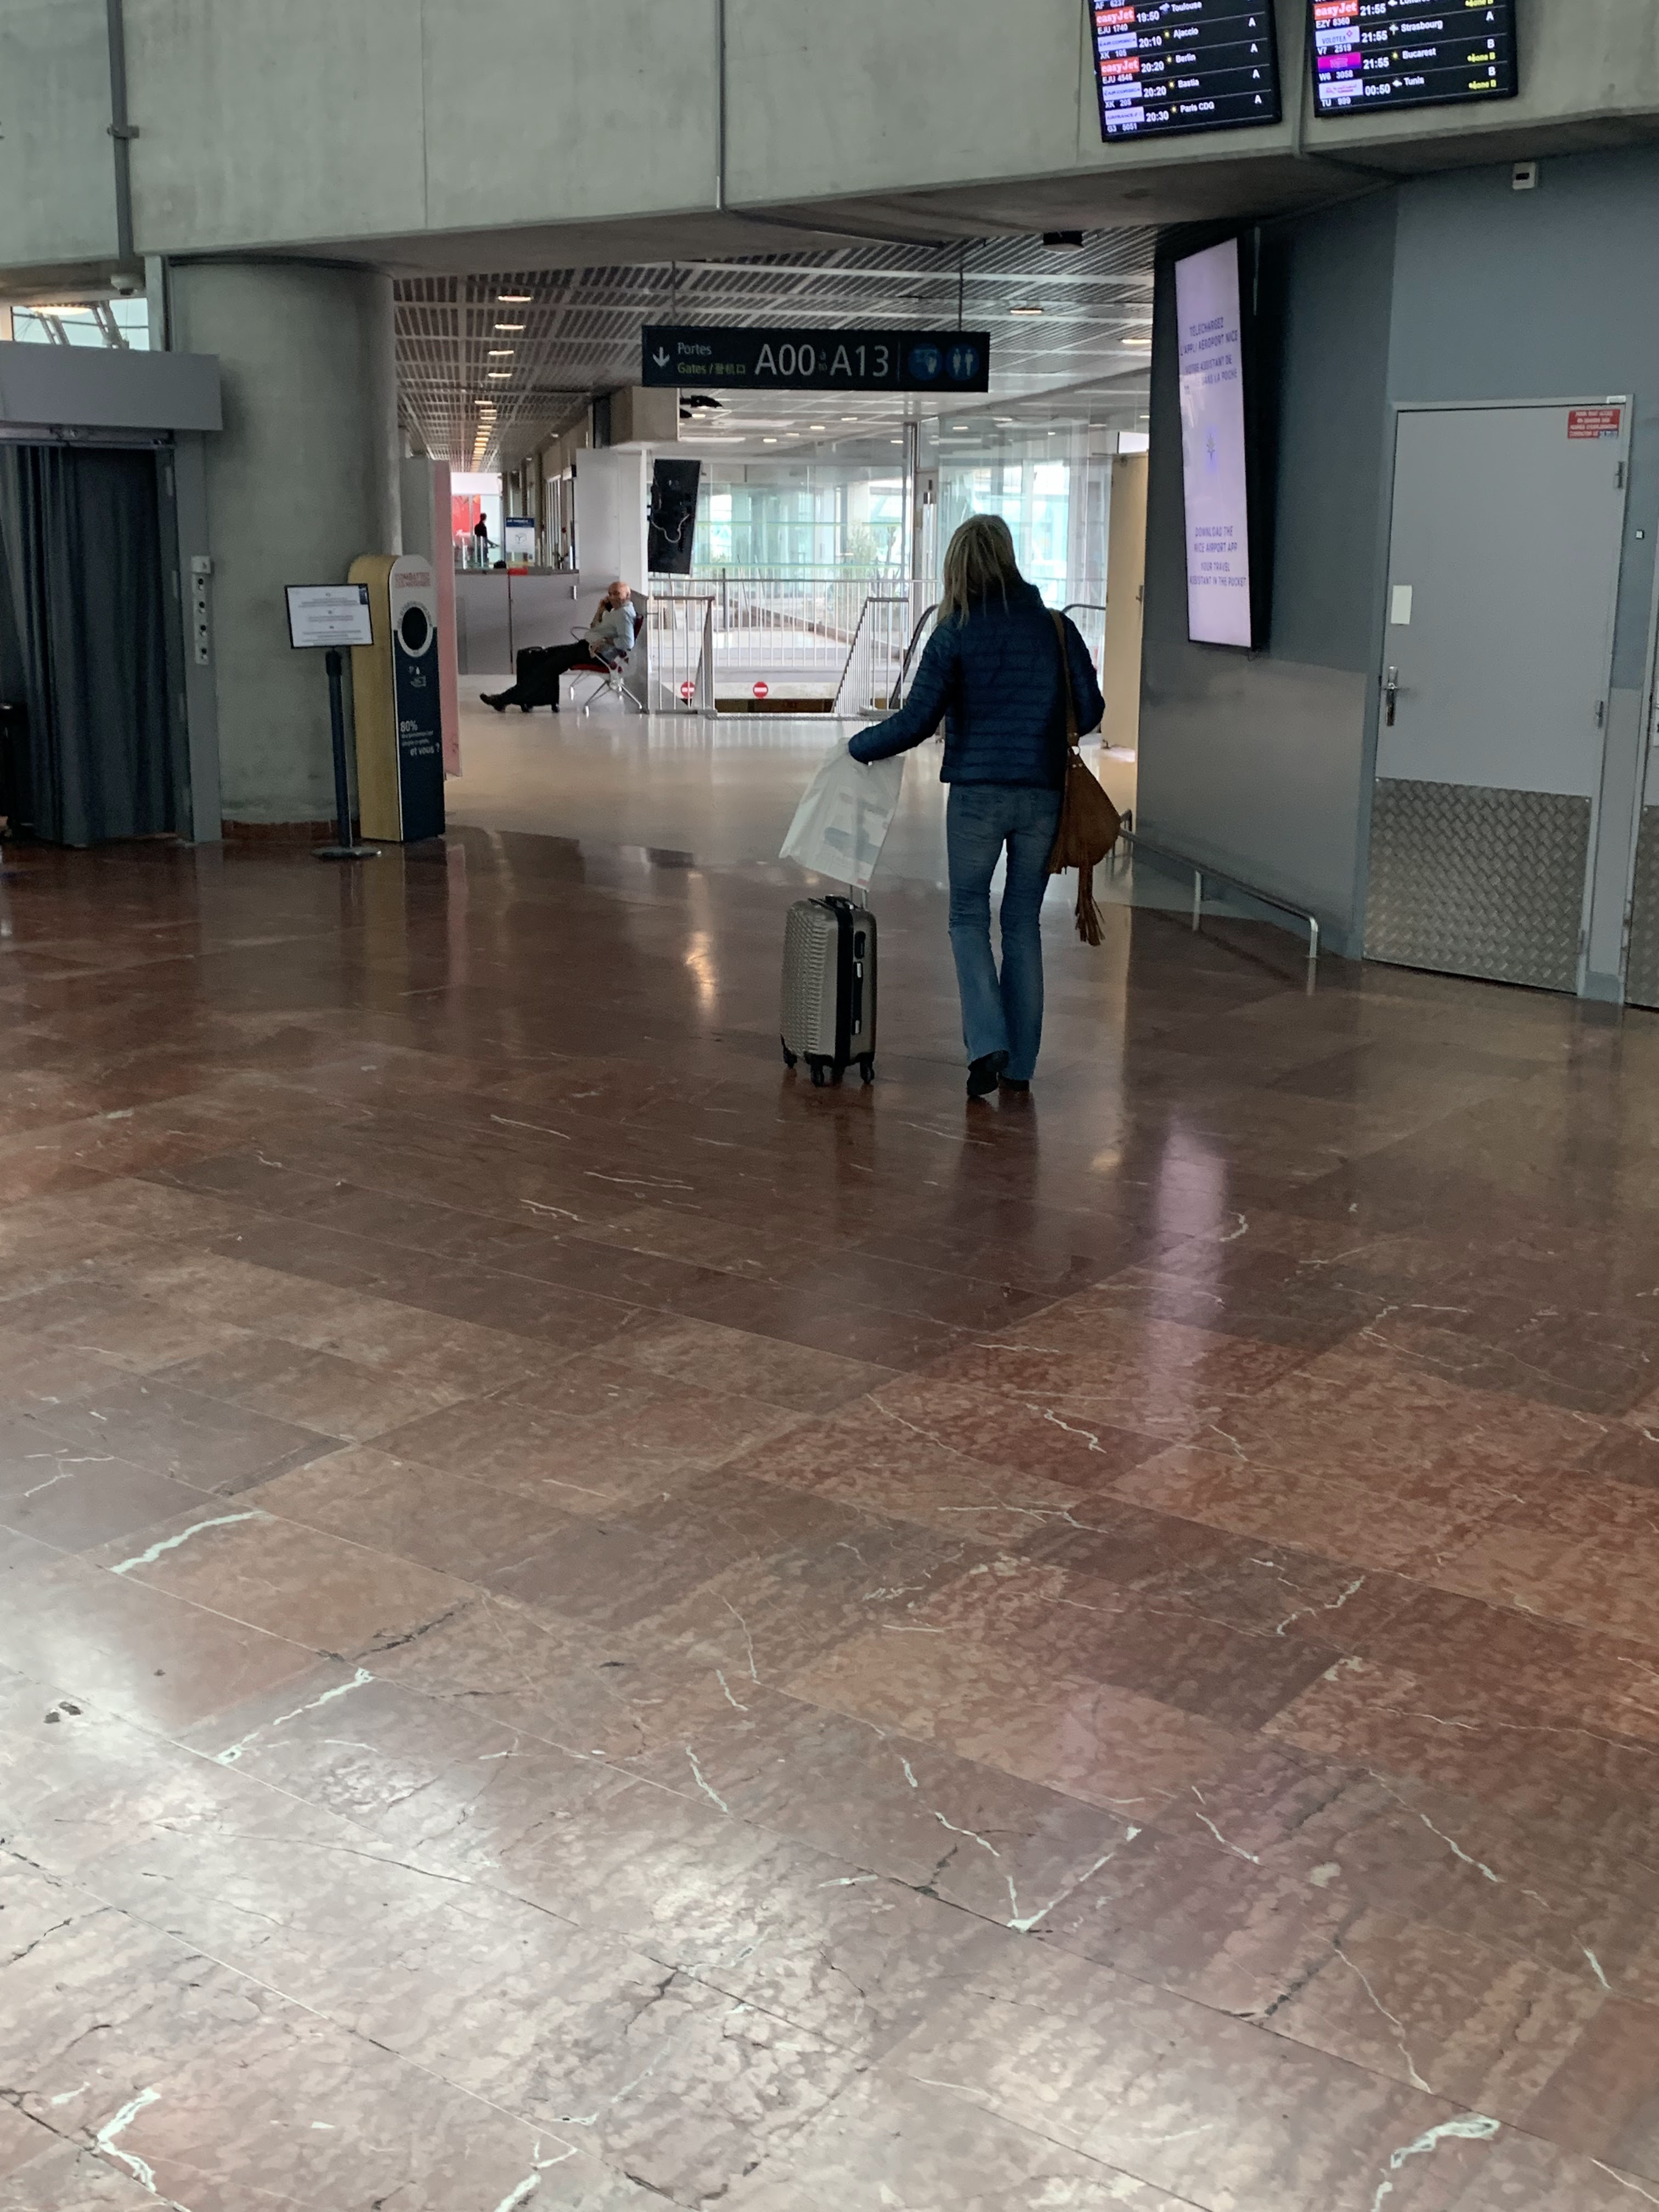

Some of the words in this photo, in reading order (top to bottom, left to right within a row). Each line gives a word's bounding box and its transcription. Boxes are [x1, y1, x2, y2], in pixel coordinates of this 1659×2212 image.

[1097, 10, 1133, 23] easyJet
[1137, 10, 1159, 22] 19:50
[1171, 2, 1202, 12] Toulouse
[1315, 2, 1357, 16] easyJet
[1360, 3, 1386, 16] 21:55
[1138, 36, 1162, 48] 20:10
[1173, 28, 1199, 39] Ajaccio
[1249, 17, 1256, 27] A
[1361, 30, 1387, 43] 21:55
[1401, 20, 1443, 32] Strasbourg
[1486, 11, 1494, 21] A
[1141, 62, 1164, 73] 20:20
[1175, 53, 1196, 63] Berlin
[1250, 43, 1258, 53] A
[1363, 57, 1389, 69] 21:55
[1402, 48, 1436, 59] Bucarest
[1487, 39, 1495, 48] B
[1101, 60, 1138, 72] easyJet
[1143, 86, 1166, 98] 20:20
[1178, 78, 1199, 88] Bastia
[1252, 69, 1260, 78] A
[1365, 83, 1391, 96] 00:50
[1403, 76, 1425, 86] Tunis
[1488, 66, 1496, 76] B
[1146, 111, 1169, 122] 20:30
[1180, 104, 1198, 113] Paris
[1199, 101, 1215, 110] CDG
[1255, 95, 1262, 104] A
[678, 342, 712, 355] Portes
[754, 343, 815, 376] A00
[830, 345, 889, 376] A13
[677, 362, 707, 374] Gates
[400, 720, 417, 732] 80%
